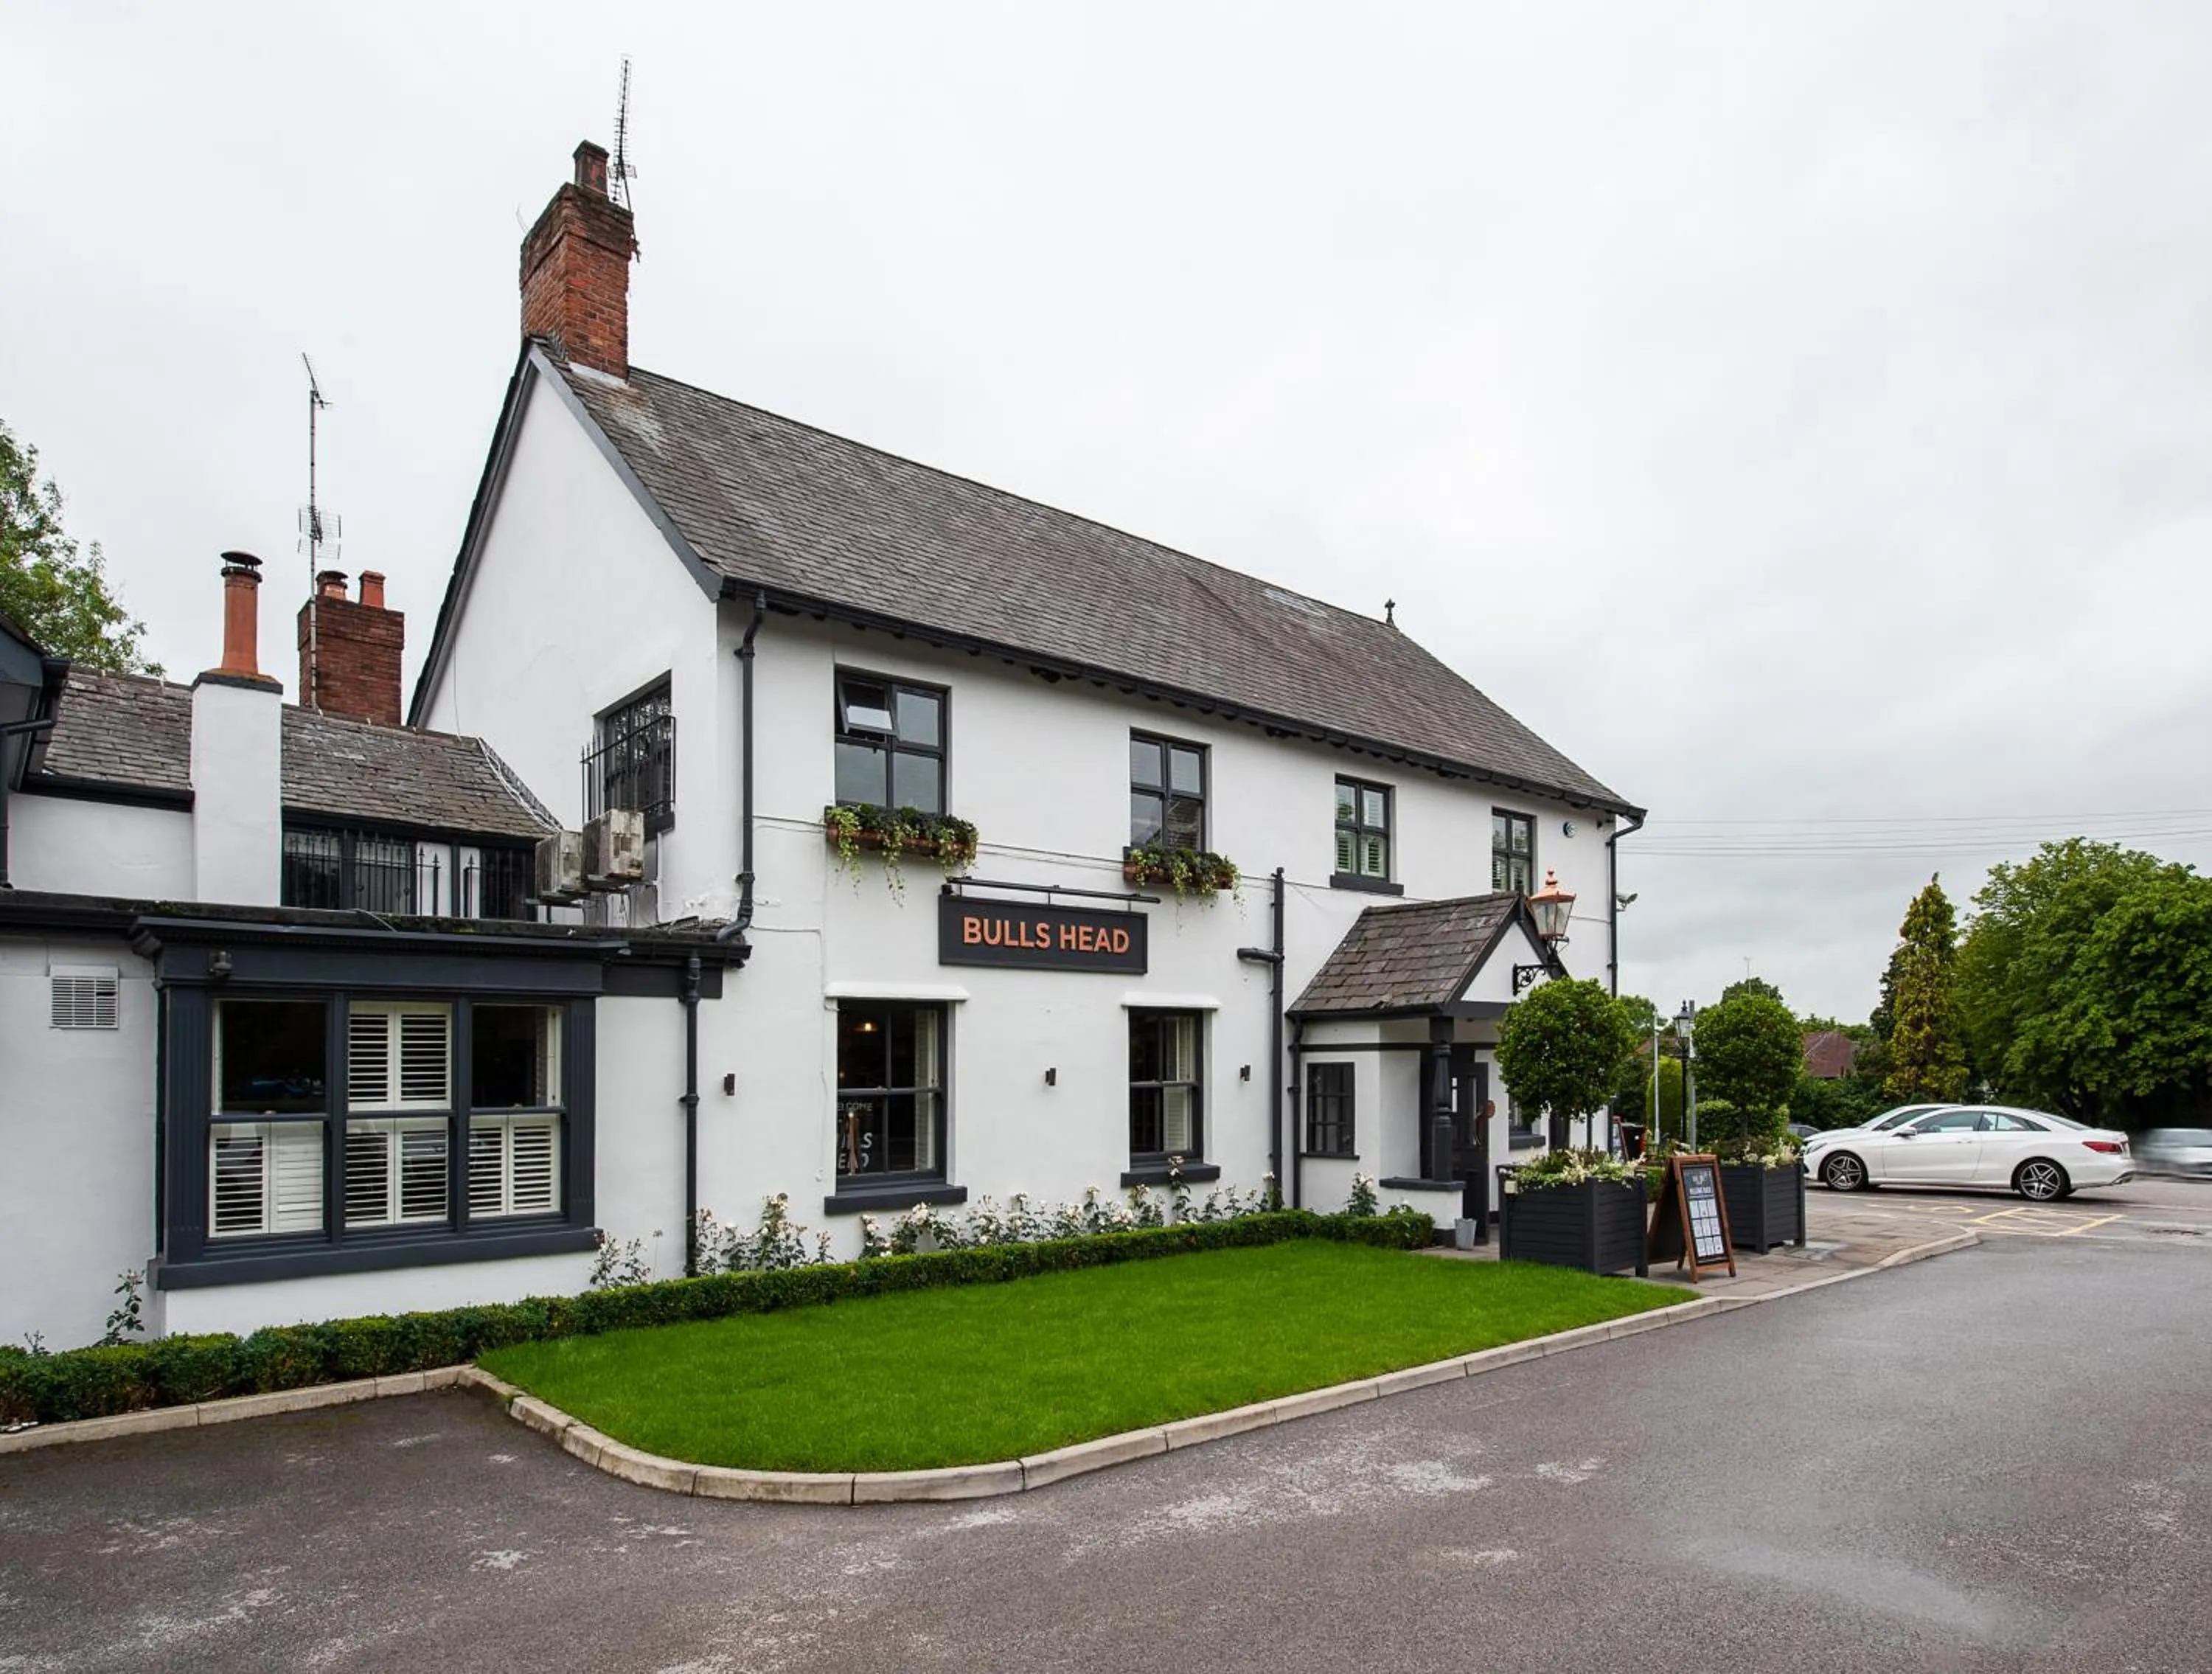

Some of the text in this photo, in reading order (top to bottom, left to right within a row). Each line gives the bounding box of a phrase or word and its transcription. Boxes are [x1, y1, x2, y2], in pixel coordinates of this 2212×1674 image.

[963, 917, 1130, 954] BULLS HEAD
[838, 1102, 873, 1111] ELCOME
